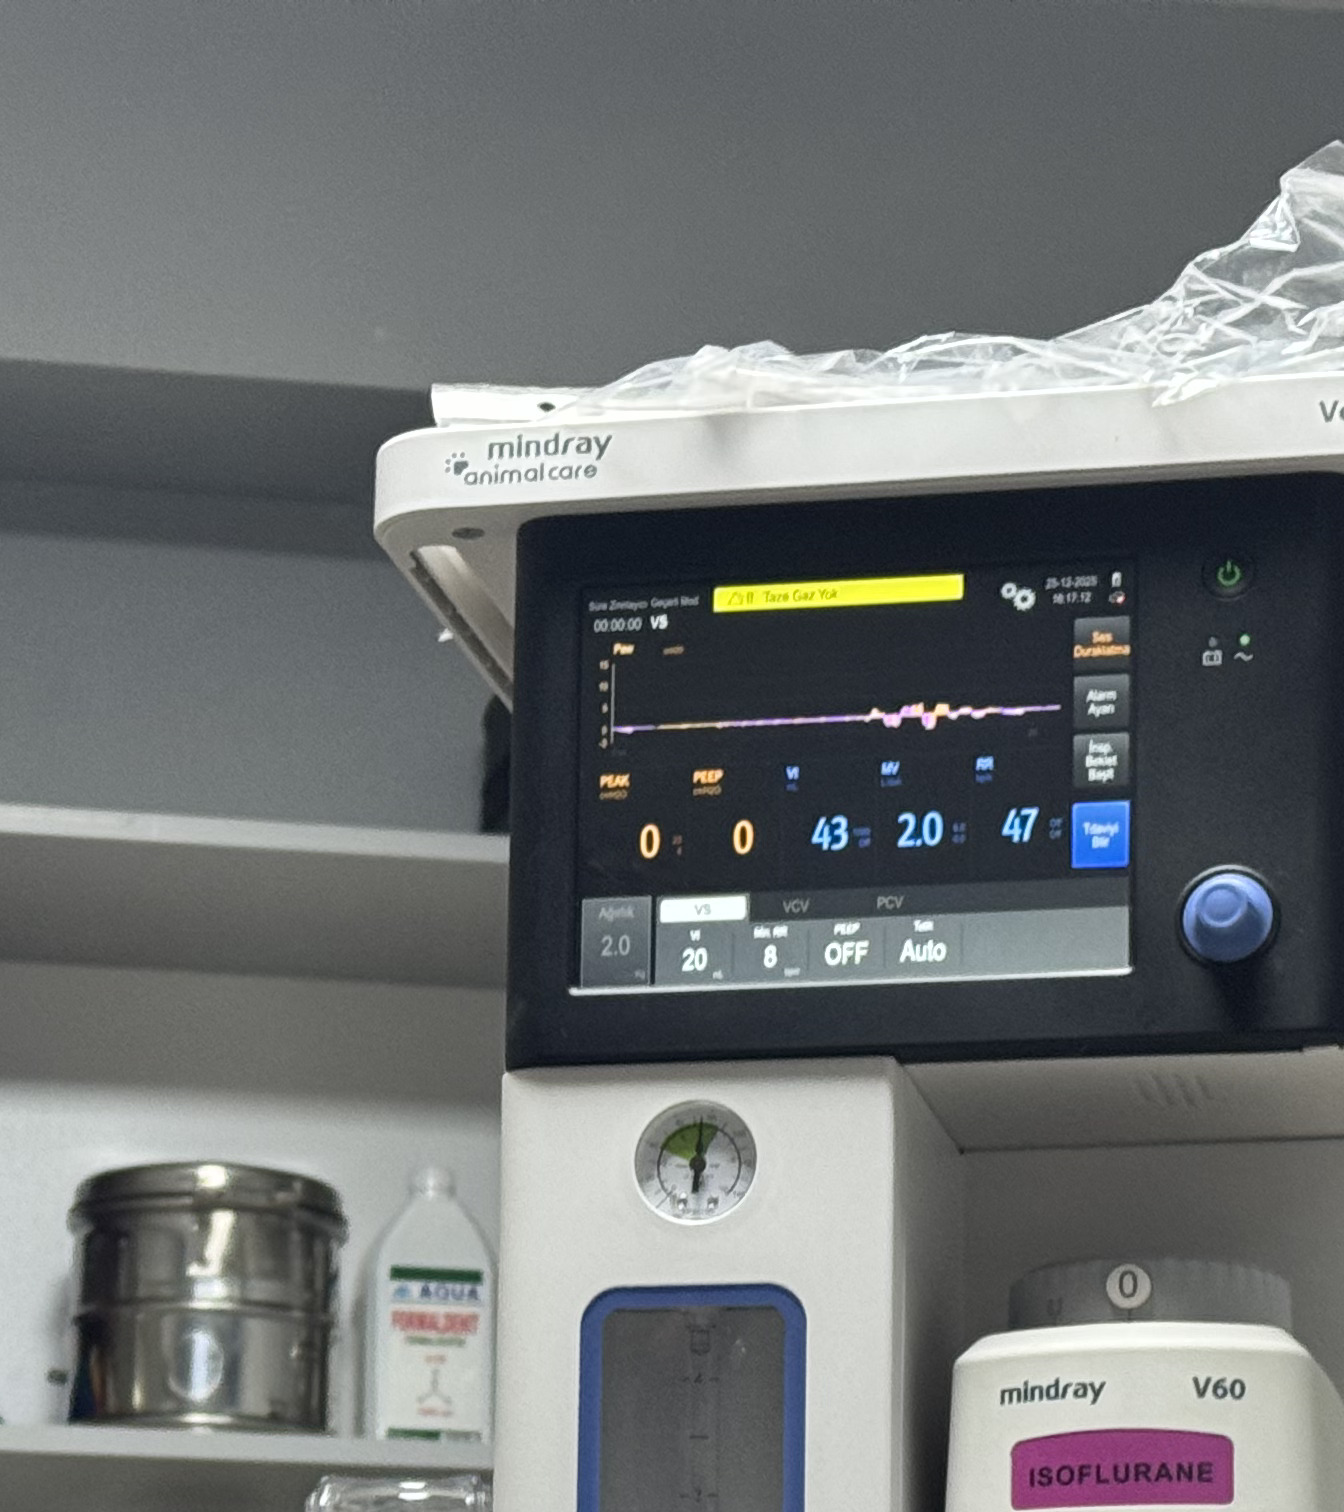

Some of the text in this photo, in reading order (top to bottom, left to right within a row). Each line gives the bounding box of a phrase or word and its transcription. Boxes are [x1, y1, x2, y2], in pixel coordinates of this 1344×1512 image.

[488, 432, 613, 461] mindray
[793, 588, 815, 602] Gaz
[650, 614, 668, 630] VS
[733, 819, 755, 856] 0
[811, 815, 849, 851] 43
[896, 810, 943, 848] 2.0
[1001, 806, 1040, 844] 47
[640, 823, 661, 859] 0
[694, 903, 712, 916] VS
[783, 899, 810, 914] VCV
[876, 896, 904, 911] PCV
[601, 935, 631, 957] 2.0
[763, 944, 778, 969] 8
[824, 940, 870, 966] OFF
[899, 938, 948, 964] Auto
[682, 947, 708, 973] 20
[999, 1378, 1106, 1406] mindray
[1193, 1376, 1246, 1401] V60
[1029, 1461, 1214, 1488] ISOFLURANE
